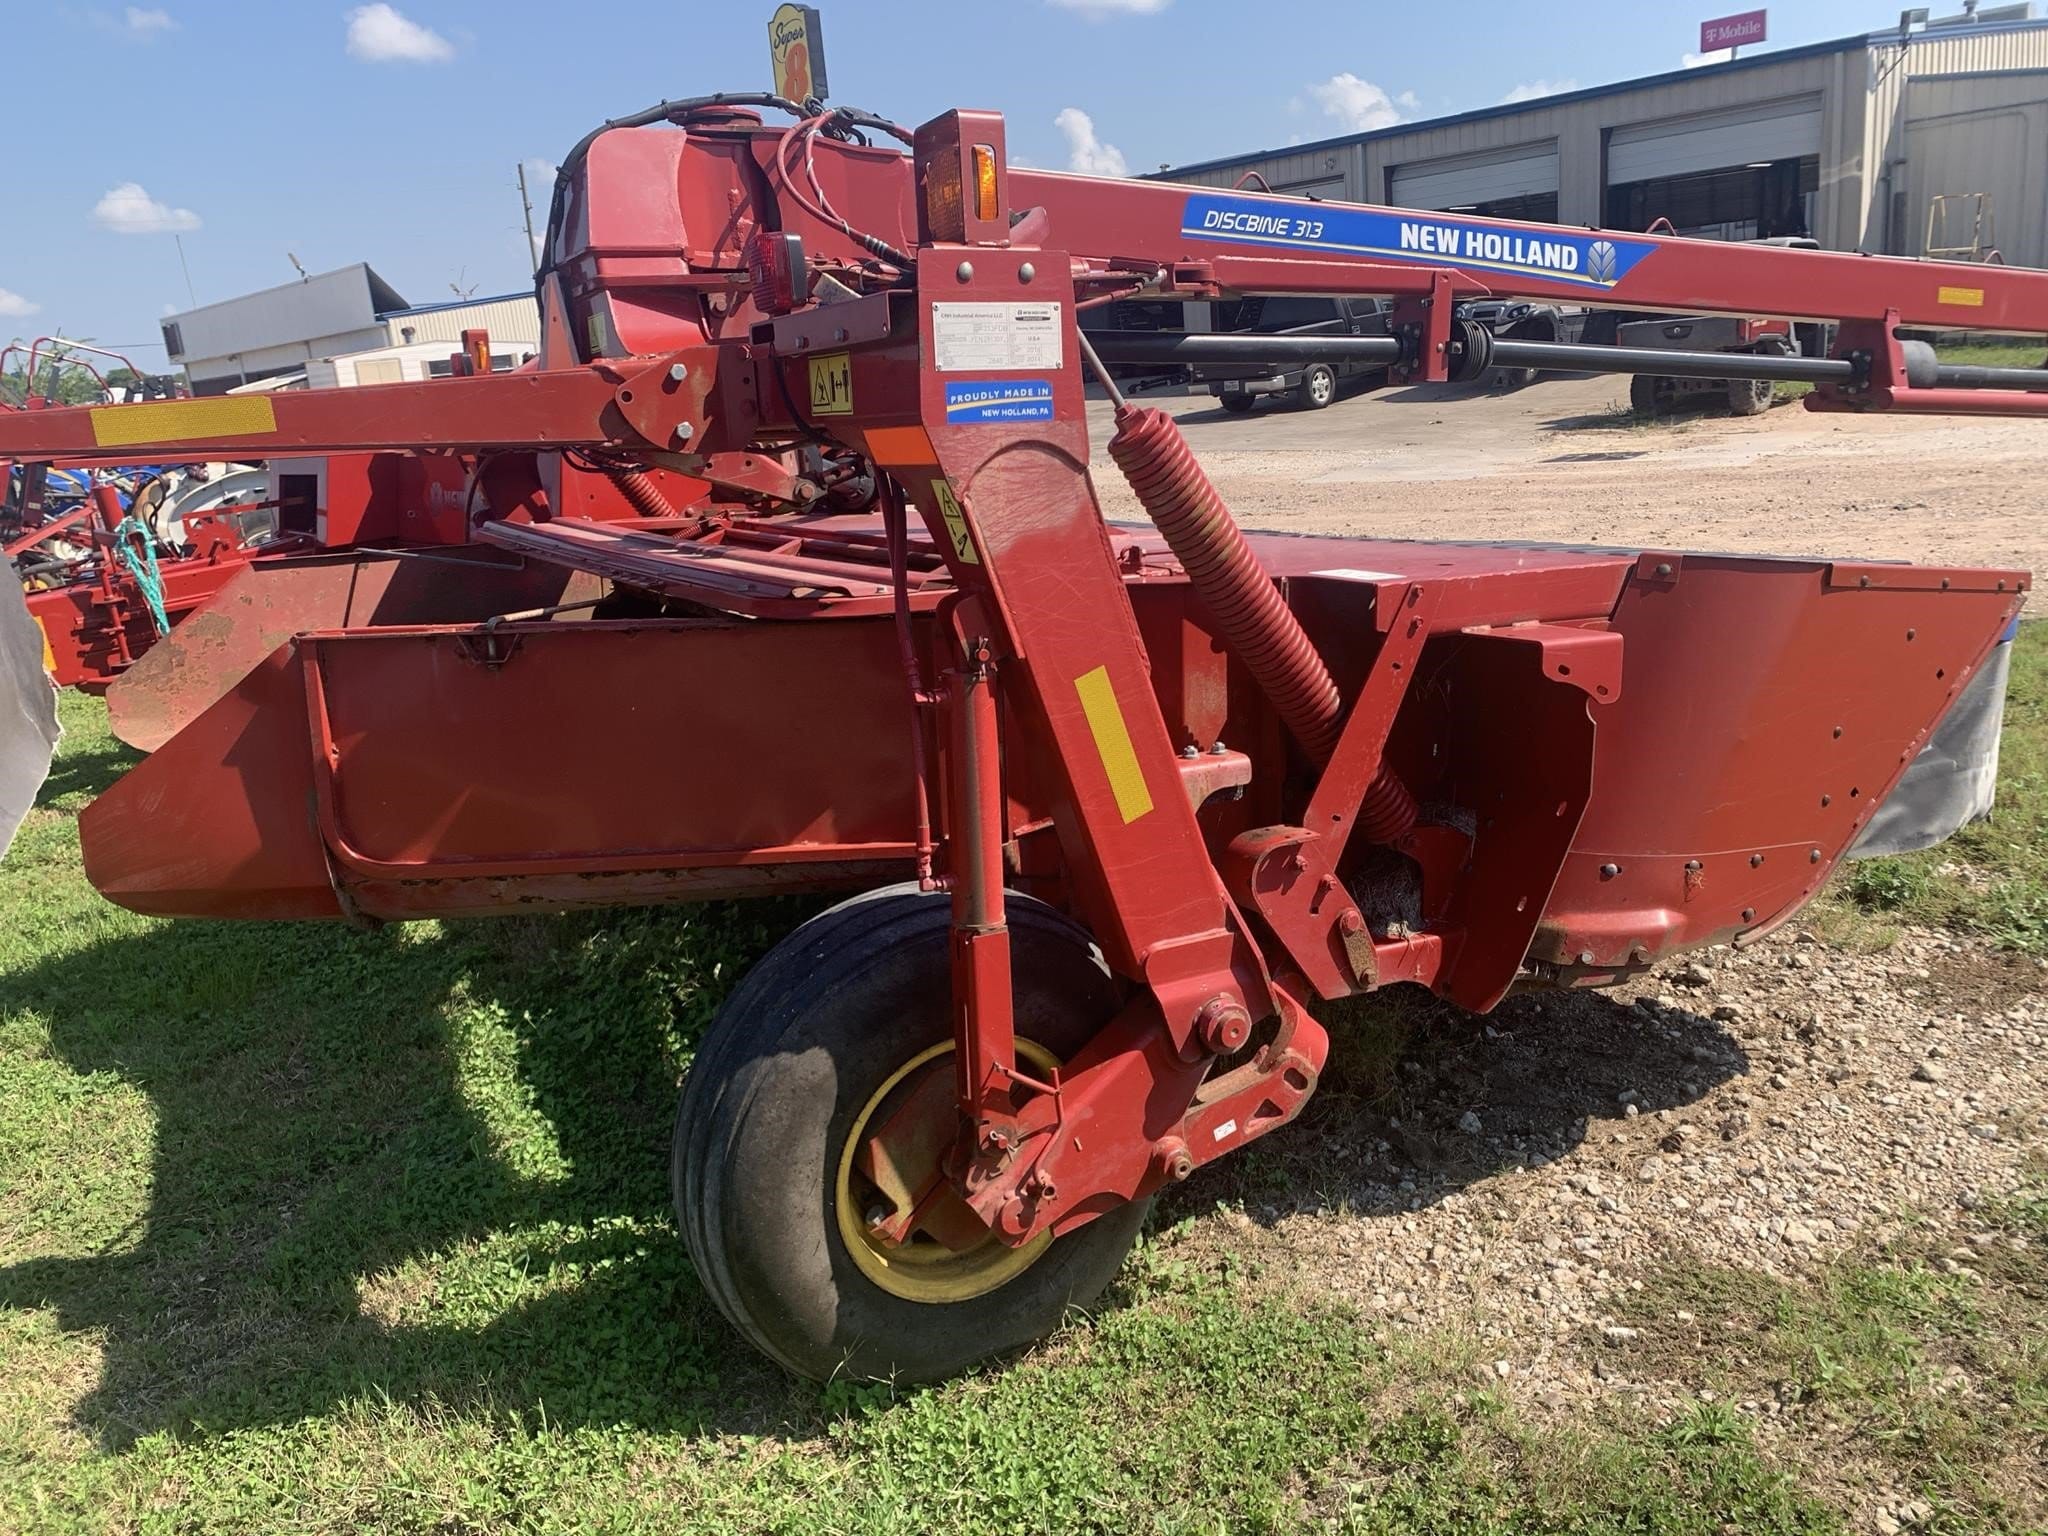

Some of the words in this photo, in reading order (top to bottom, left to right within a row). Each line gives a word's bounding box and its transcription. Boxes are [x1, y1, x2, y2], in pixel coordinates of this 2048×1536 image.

[774, 22, 805, 58] Super
[1719, 20, 1761, 40] Mobile
[783, 42, 809, 105] 8
[1203, 209, 1290, 236] DISCBINE
[1292, 219, 1324, 239] 313
[1400, 222, 1460, 255] NEW
[1465, 230, 1579, 272] HOLLAND
[950, 389, 1000, 404] PROUDLY
[1004, 387, 1033, 397] MADE
[1038, 386, 1049, 396] IN
[981, 409, 1000, 417] NEW
[1001, 408, 1039, 417] HOLLAND,
[1040, 407, 1049, 415] PA
